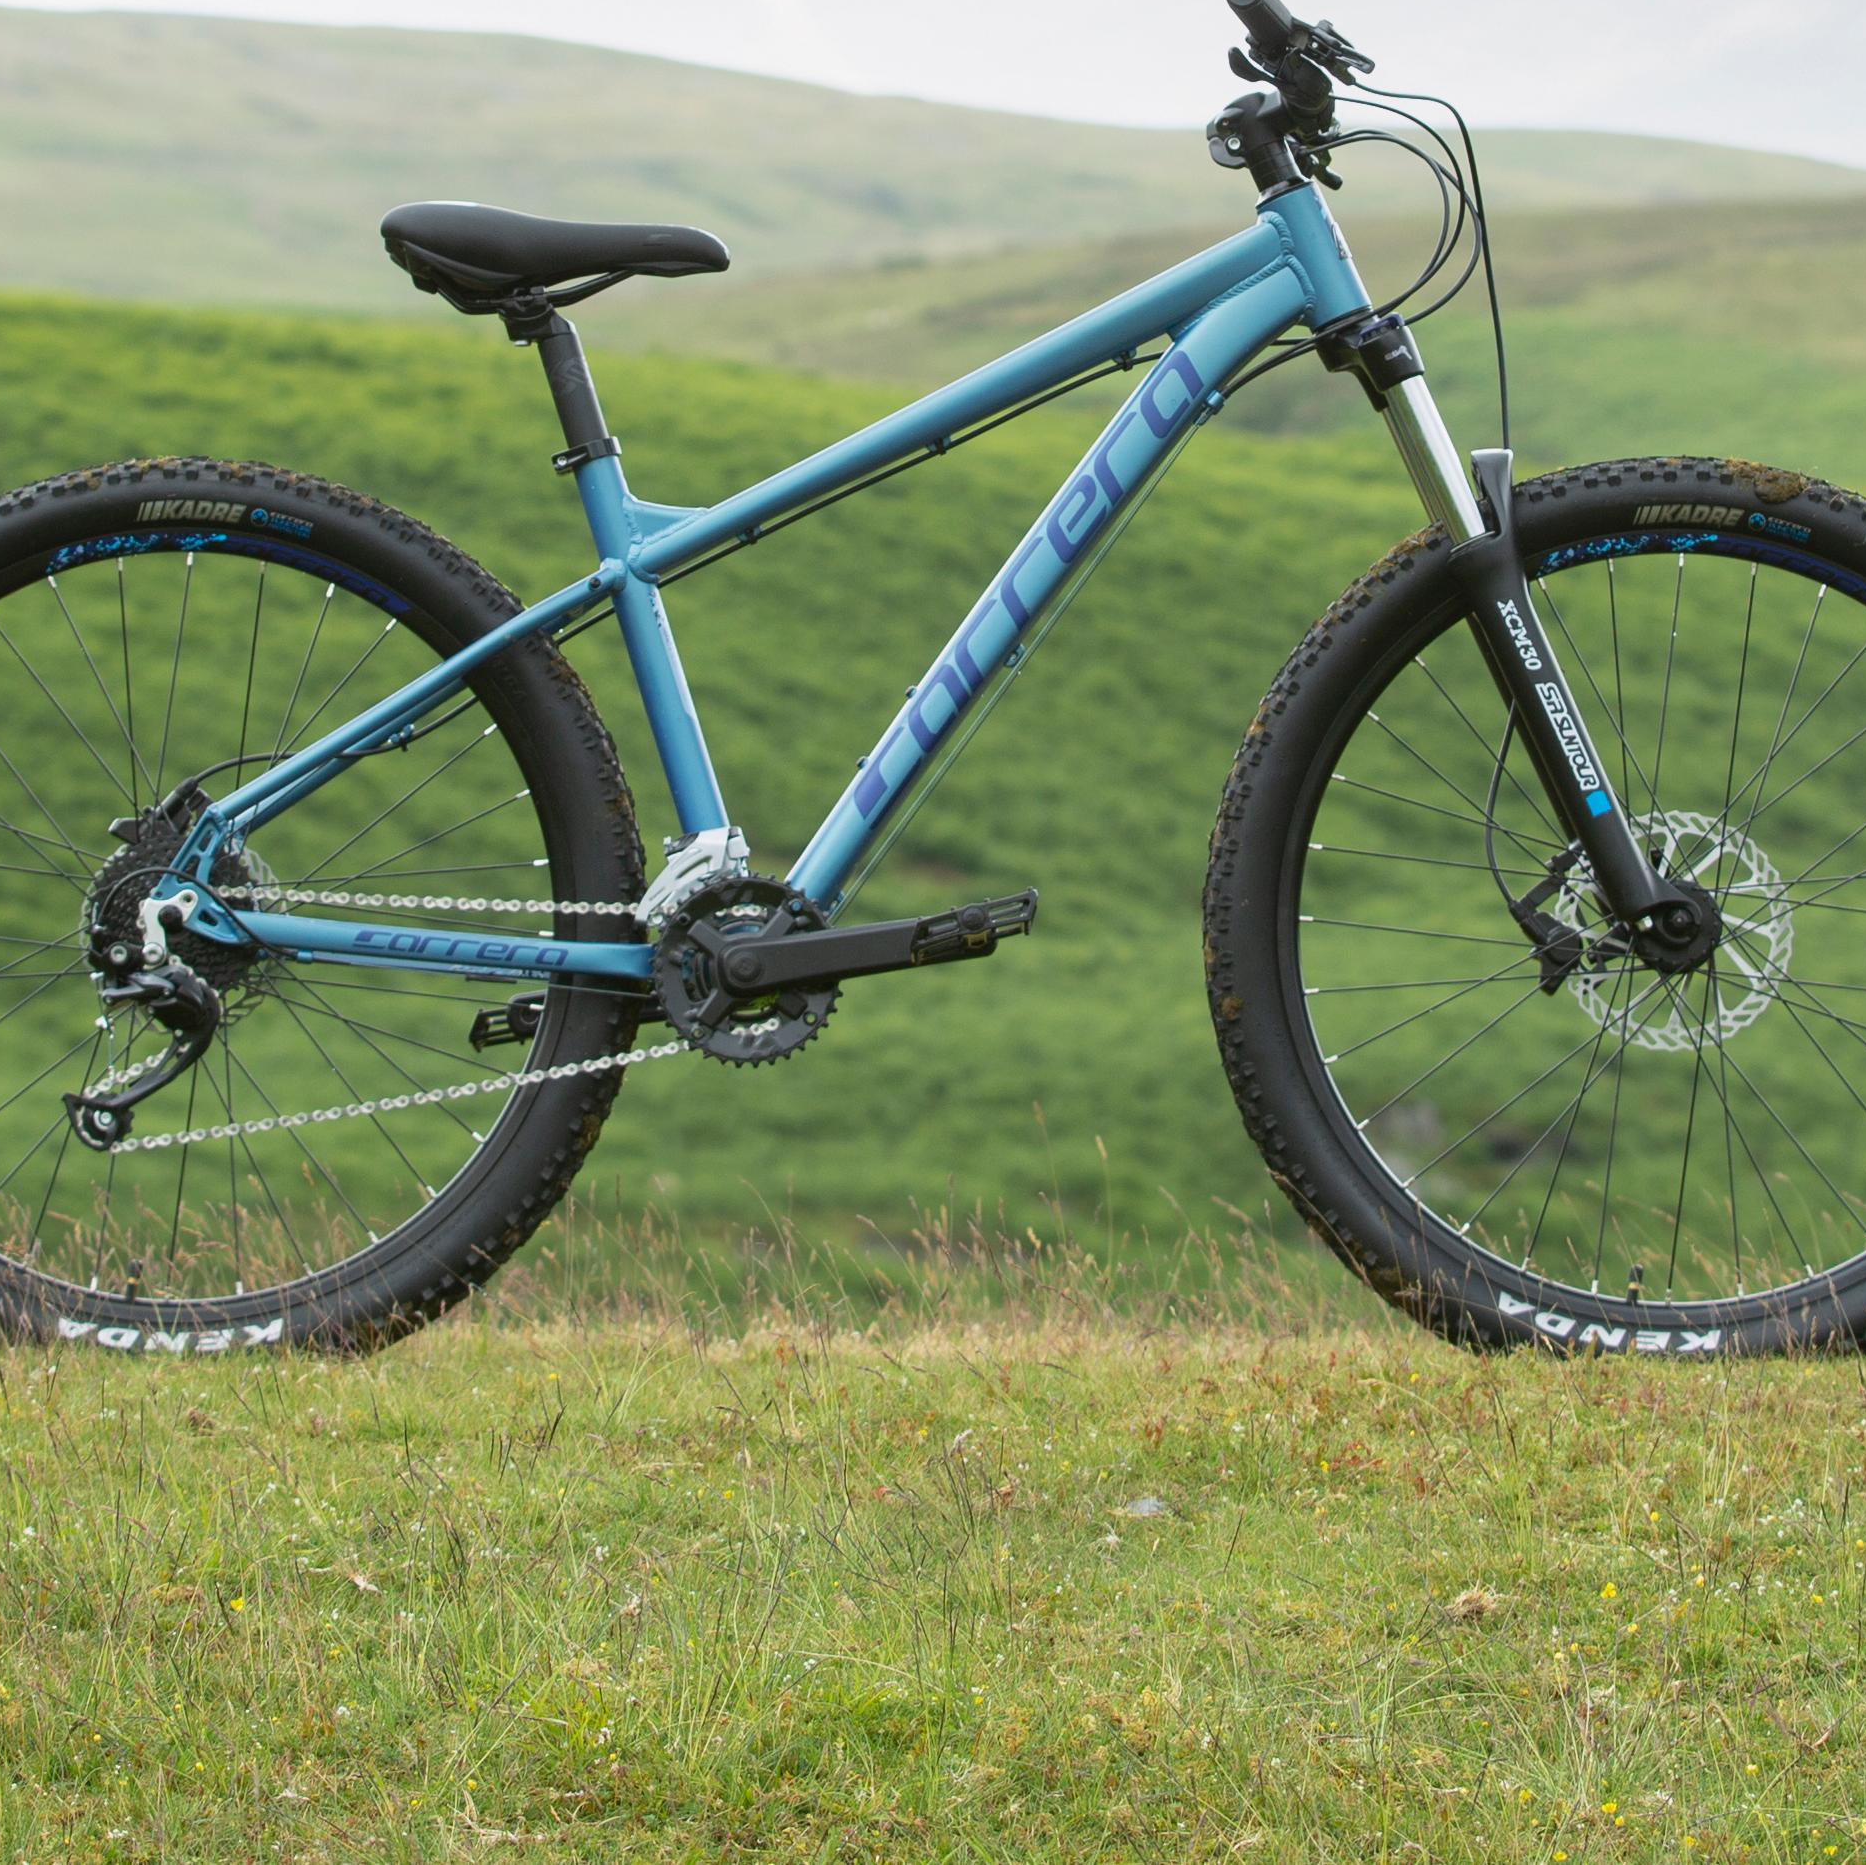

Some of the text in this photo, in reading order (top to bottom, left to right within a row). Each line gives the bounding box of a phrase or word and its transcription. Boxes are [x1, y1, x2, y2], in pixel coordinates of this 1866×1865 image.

[161, 499, 247, 523] KADRE
[1659, 503, 1746, 527] KADRE
[855, 349, 1205, 831] carrera
[1497, 598, 1542, 671] XCM30
[1535, 682, 1568, 716] SR
[352, 930, 570, 968] carrera
[58, 1316, 284, 1353] KENDA
[1498, 1291, 1722, 1352] KENDA
